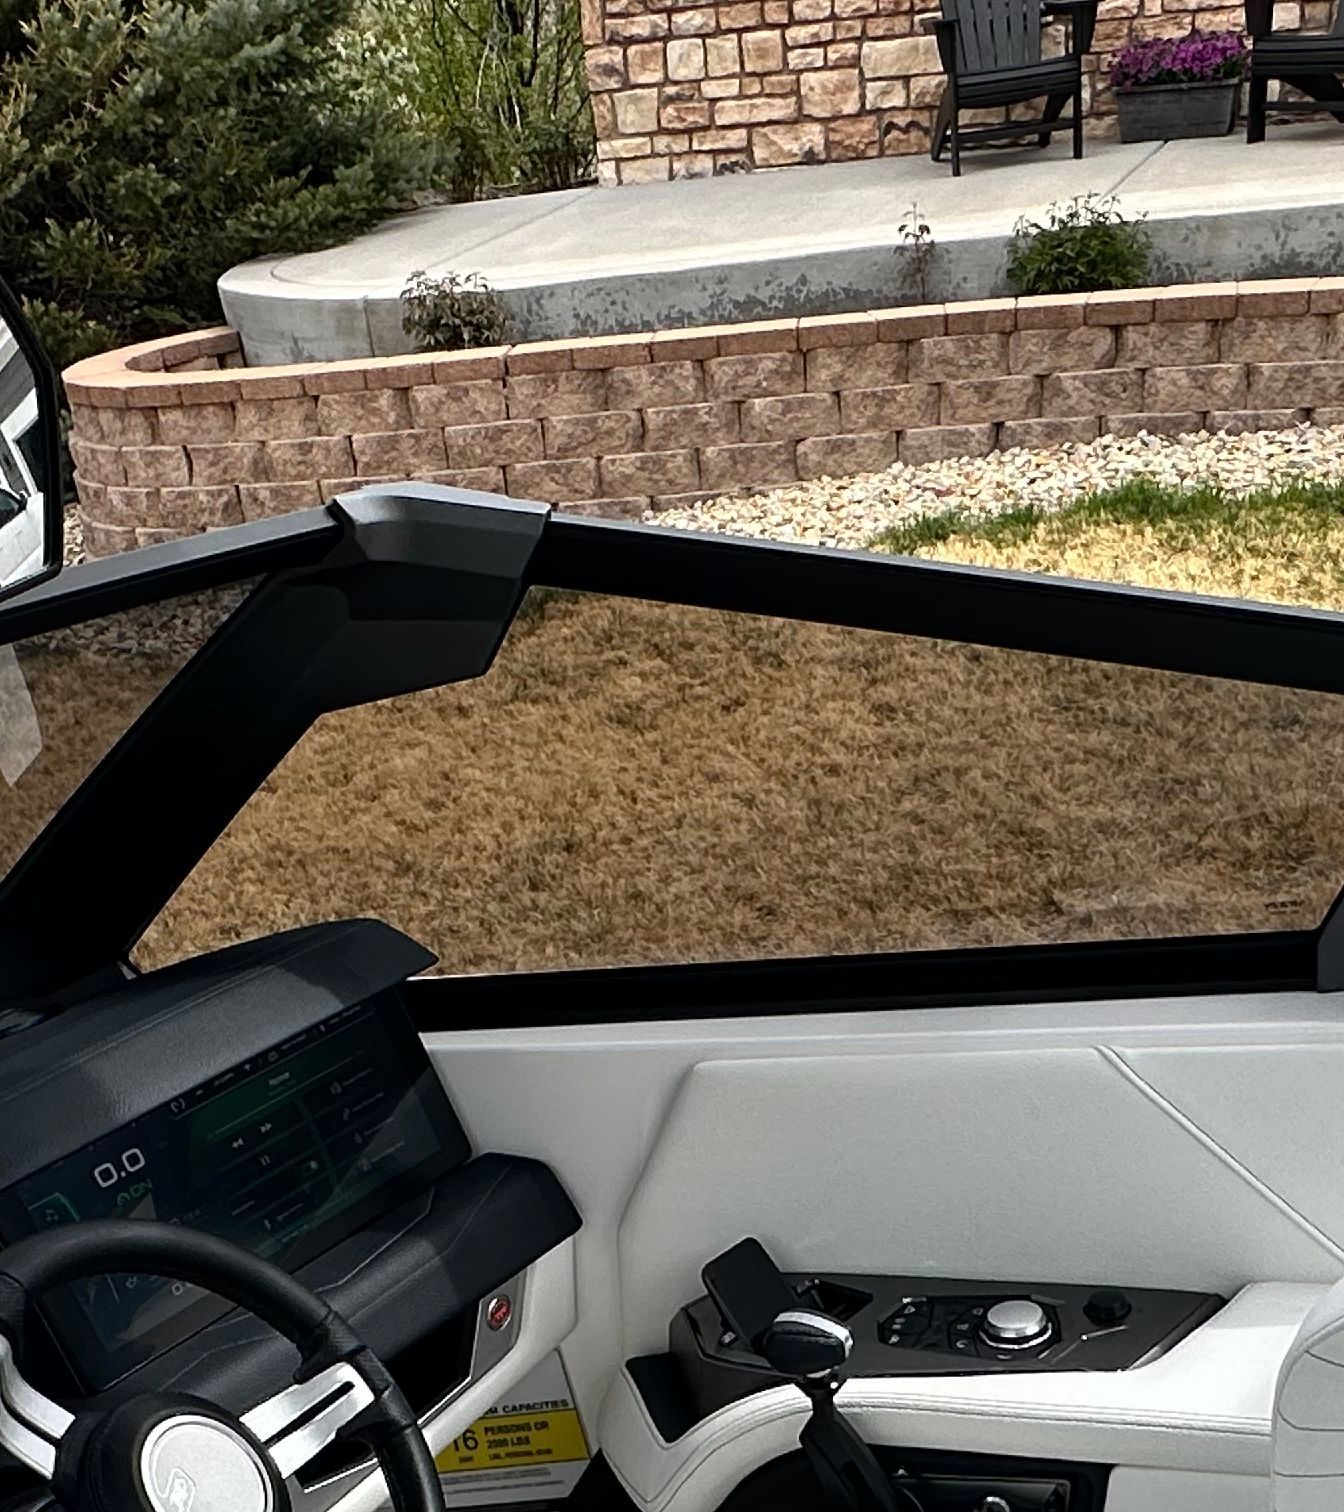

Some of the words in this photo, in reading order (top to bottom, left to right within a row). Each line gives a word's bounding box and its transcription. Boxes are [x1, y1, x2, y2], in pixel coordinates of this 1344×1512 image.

[94, 1148, 146, 1188] 0.0
[502, 1399, 569, 1414] CAPACITIES
[484, 1422, 532, 1436] PERSONS
[533, 1420, 550, 1432] OR
[510, 1435, 531, 1447] LBS
